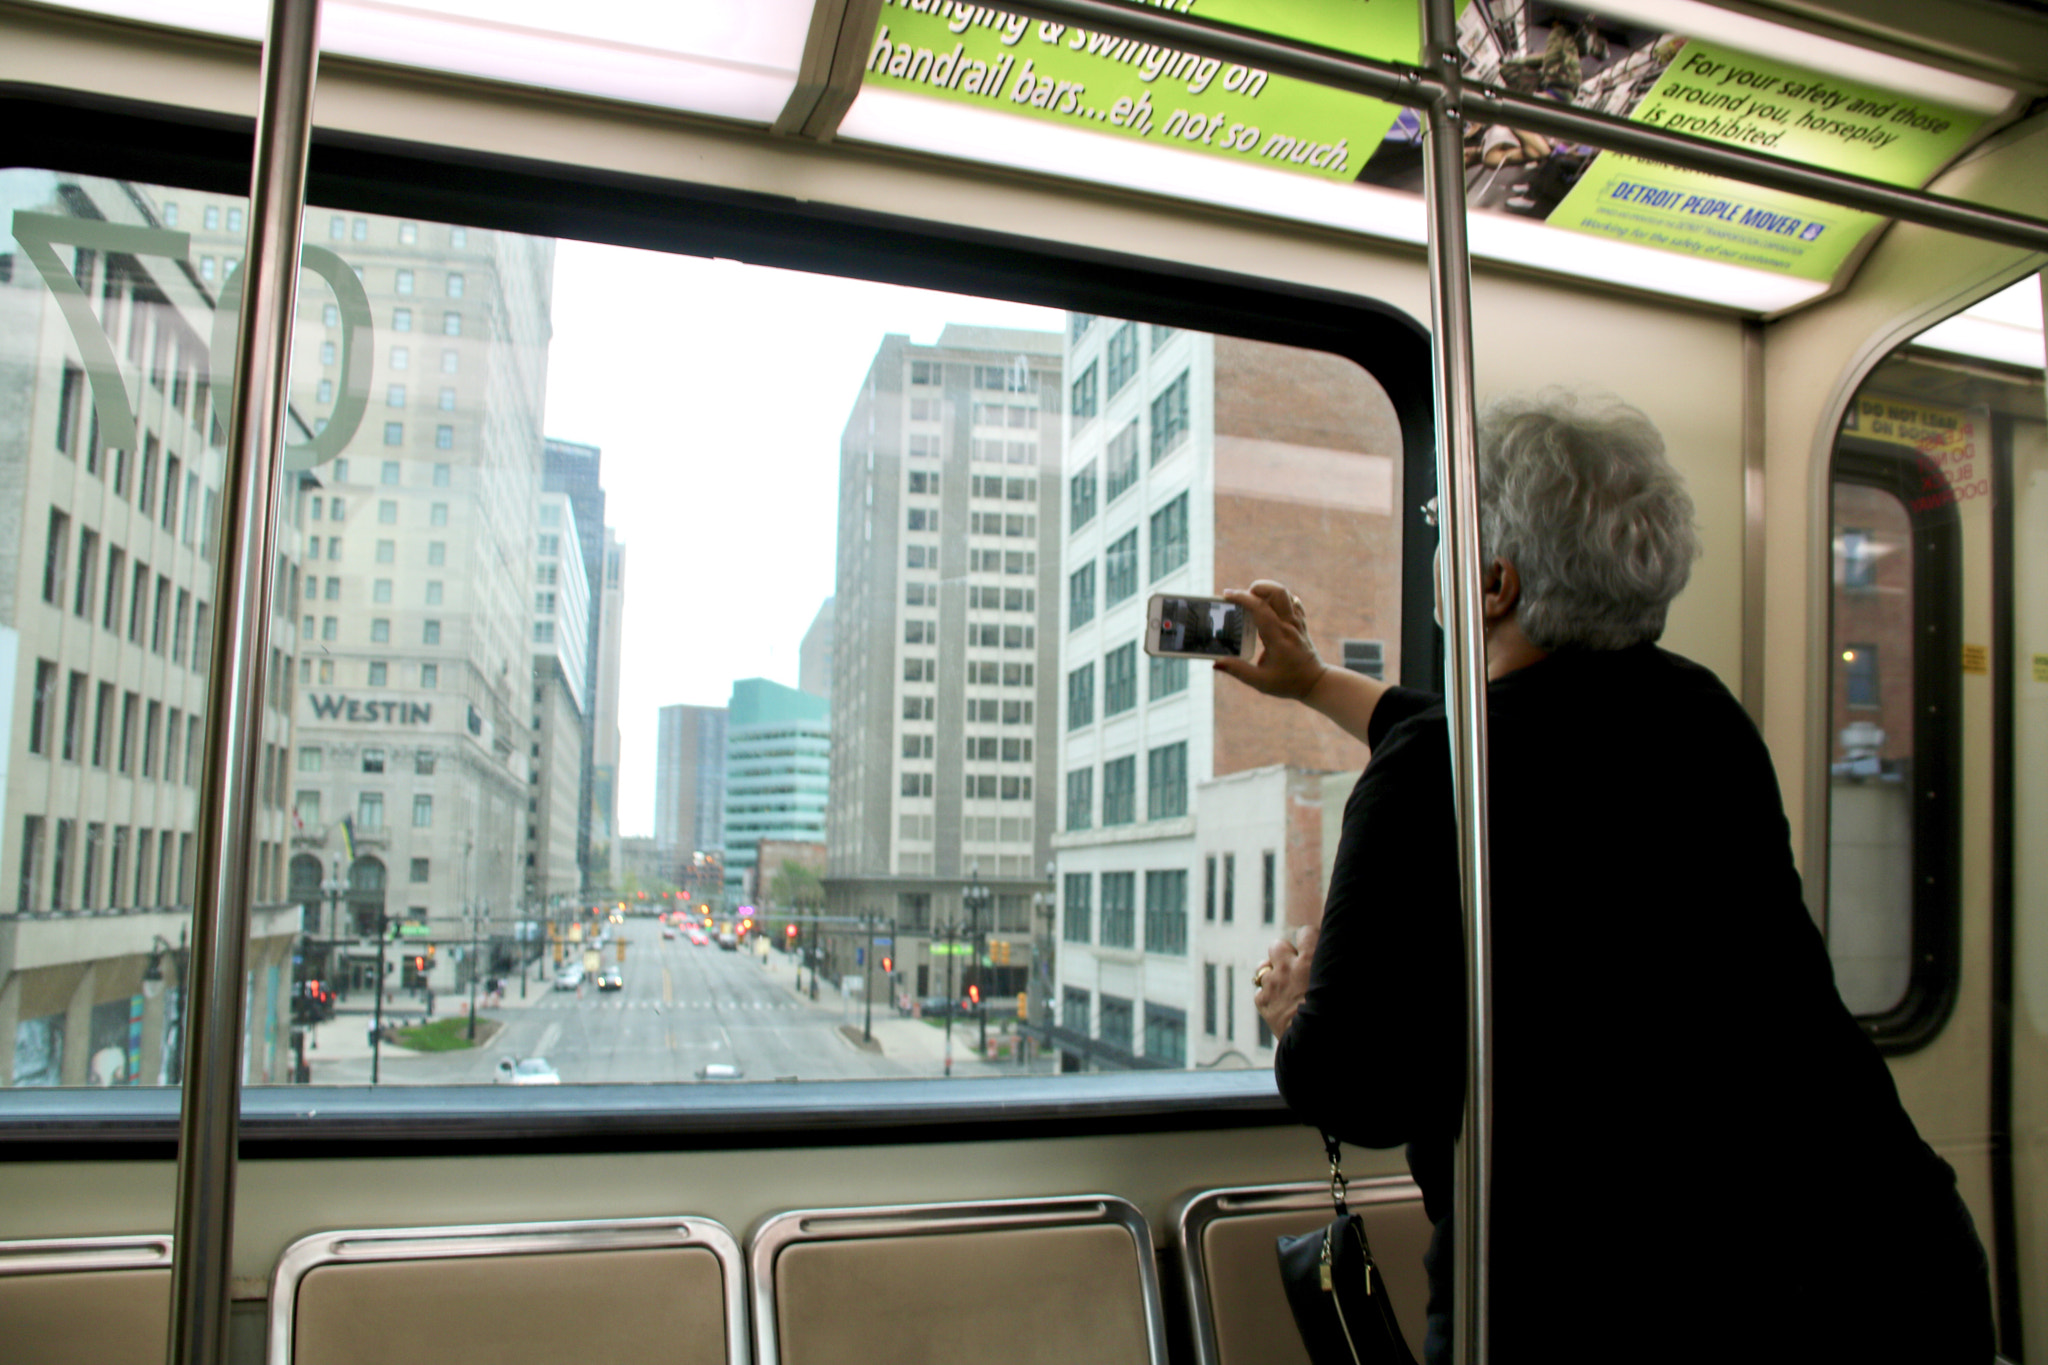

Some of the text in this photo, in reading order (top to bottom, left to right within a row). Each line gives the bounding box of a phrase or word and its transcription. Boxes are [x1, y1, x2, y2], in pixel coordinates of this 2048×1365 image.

[865, 24, 1016, 98] handrail
[1161, 108, 1226, 145] not
[1219, 123, 1261, 152] so
[1259, 133, 1350, 173] much.
[1222, 63, 1269, 98] on
[1680, 52, 1951, 134] For your safety and those
[1642, 102, 1787, 149] is prohibited.
[1661, 82, 1900, 151] around you, horseplay
[1610, 180, 1686, 211] DETROIT
[1678, 194, 1743, 223] PEOPLE
[1738, 206, 1803, 237] MOVER
[1862, 400, 1885, 418] DO
[1887, 405, 1918, 423] NOT
[1872, 419, 1894, 436] ON
[308, 692, 432, 724] WESTIN
